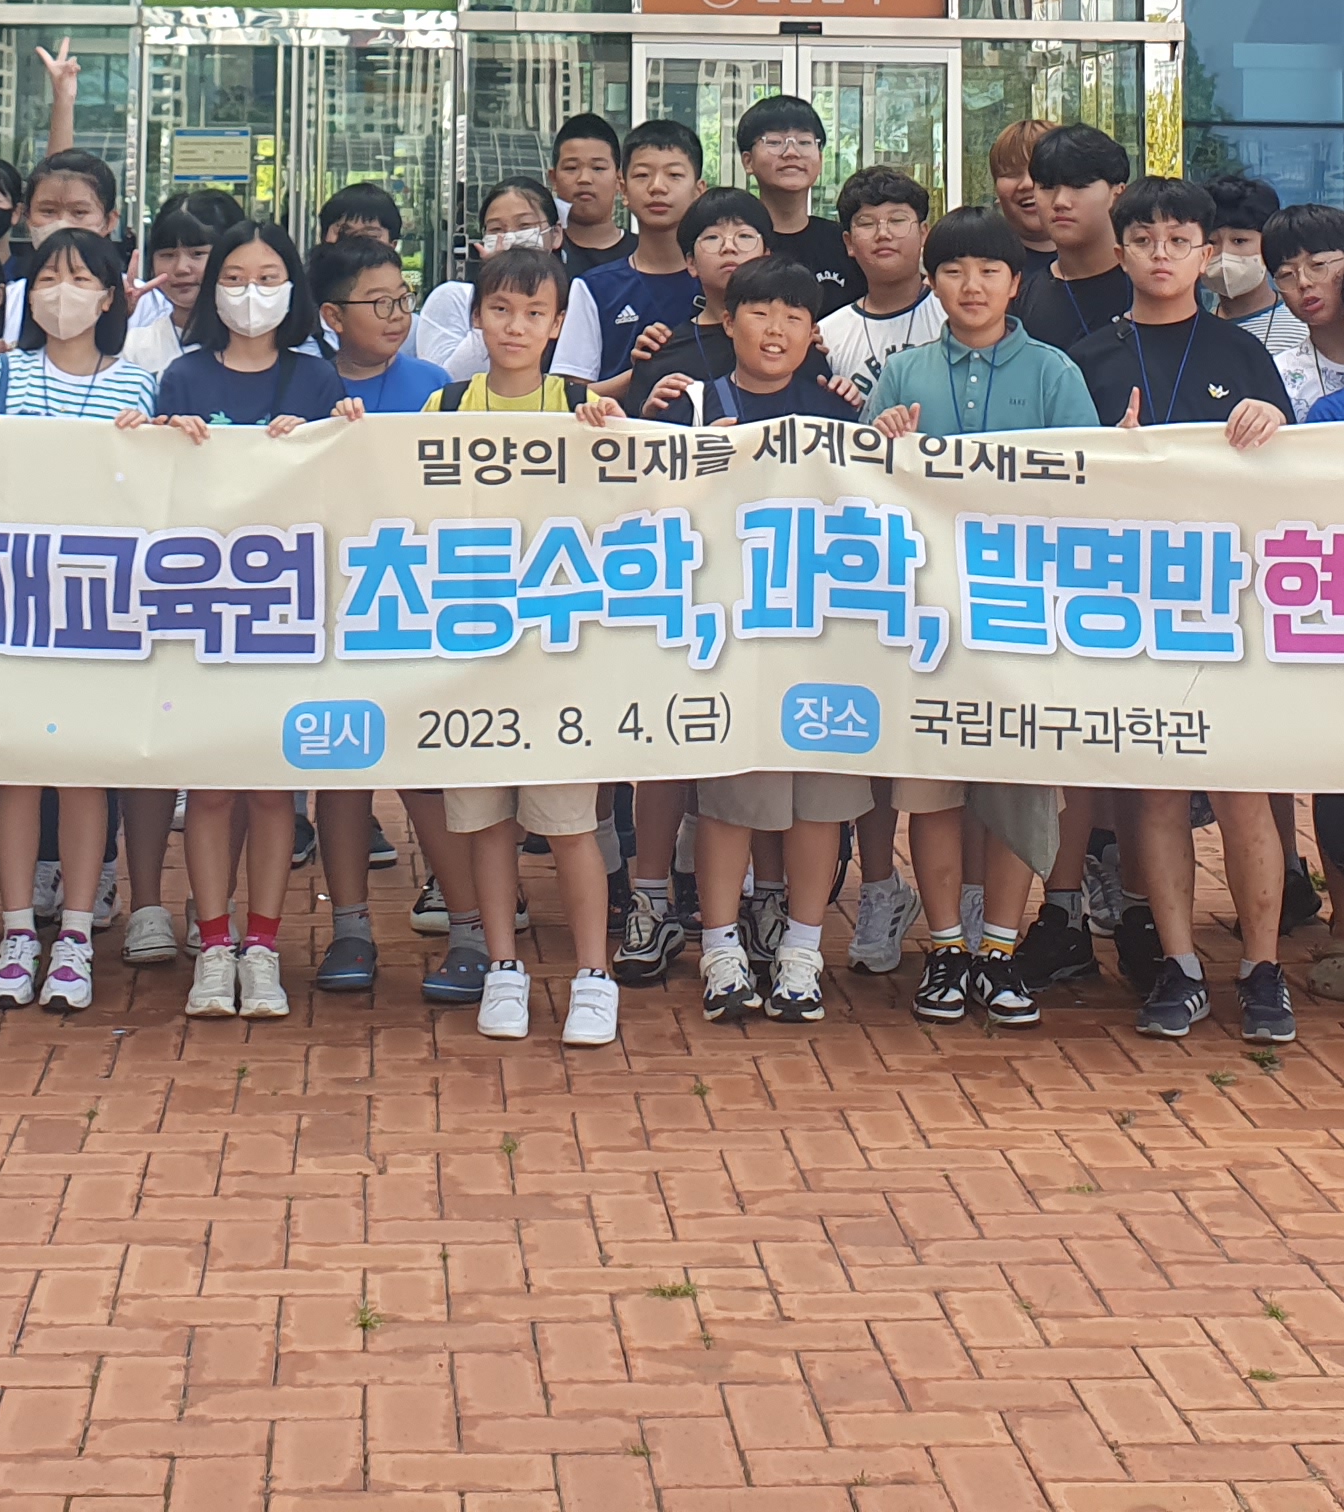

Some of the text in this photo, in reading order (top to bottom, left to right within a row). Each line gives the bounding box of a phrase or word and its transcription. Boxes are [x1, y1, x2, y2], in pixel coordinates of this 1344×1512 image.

[417, 436, 566, 486] 밀양의
[591, 432, 737, 484] 인재를
[752, 417, 893, 475] 세계의
[341, 510, 722, 666] 초등수학,
[736, 498, 948, 668] 과학,
[960, 518, 1246, 658] 발명반
[294, 710, 371, 756] 일시
[417, 708, 531, 750] 2023.
[558, 706, 592, 747] 8.
[793, 695, 1210, 755] 장소 국립대구과학관
